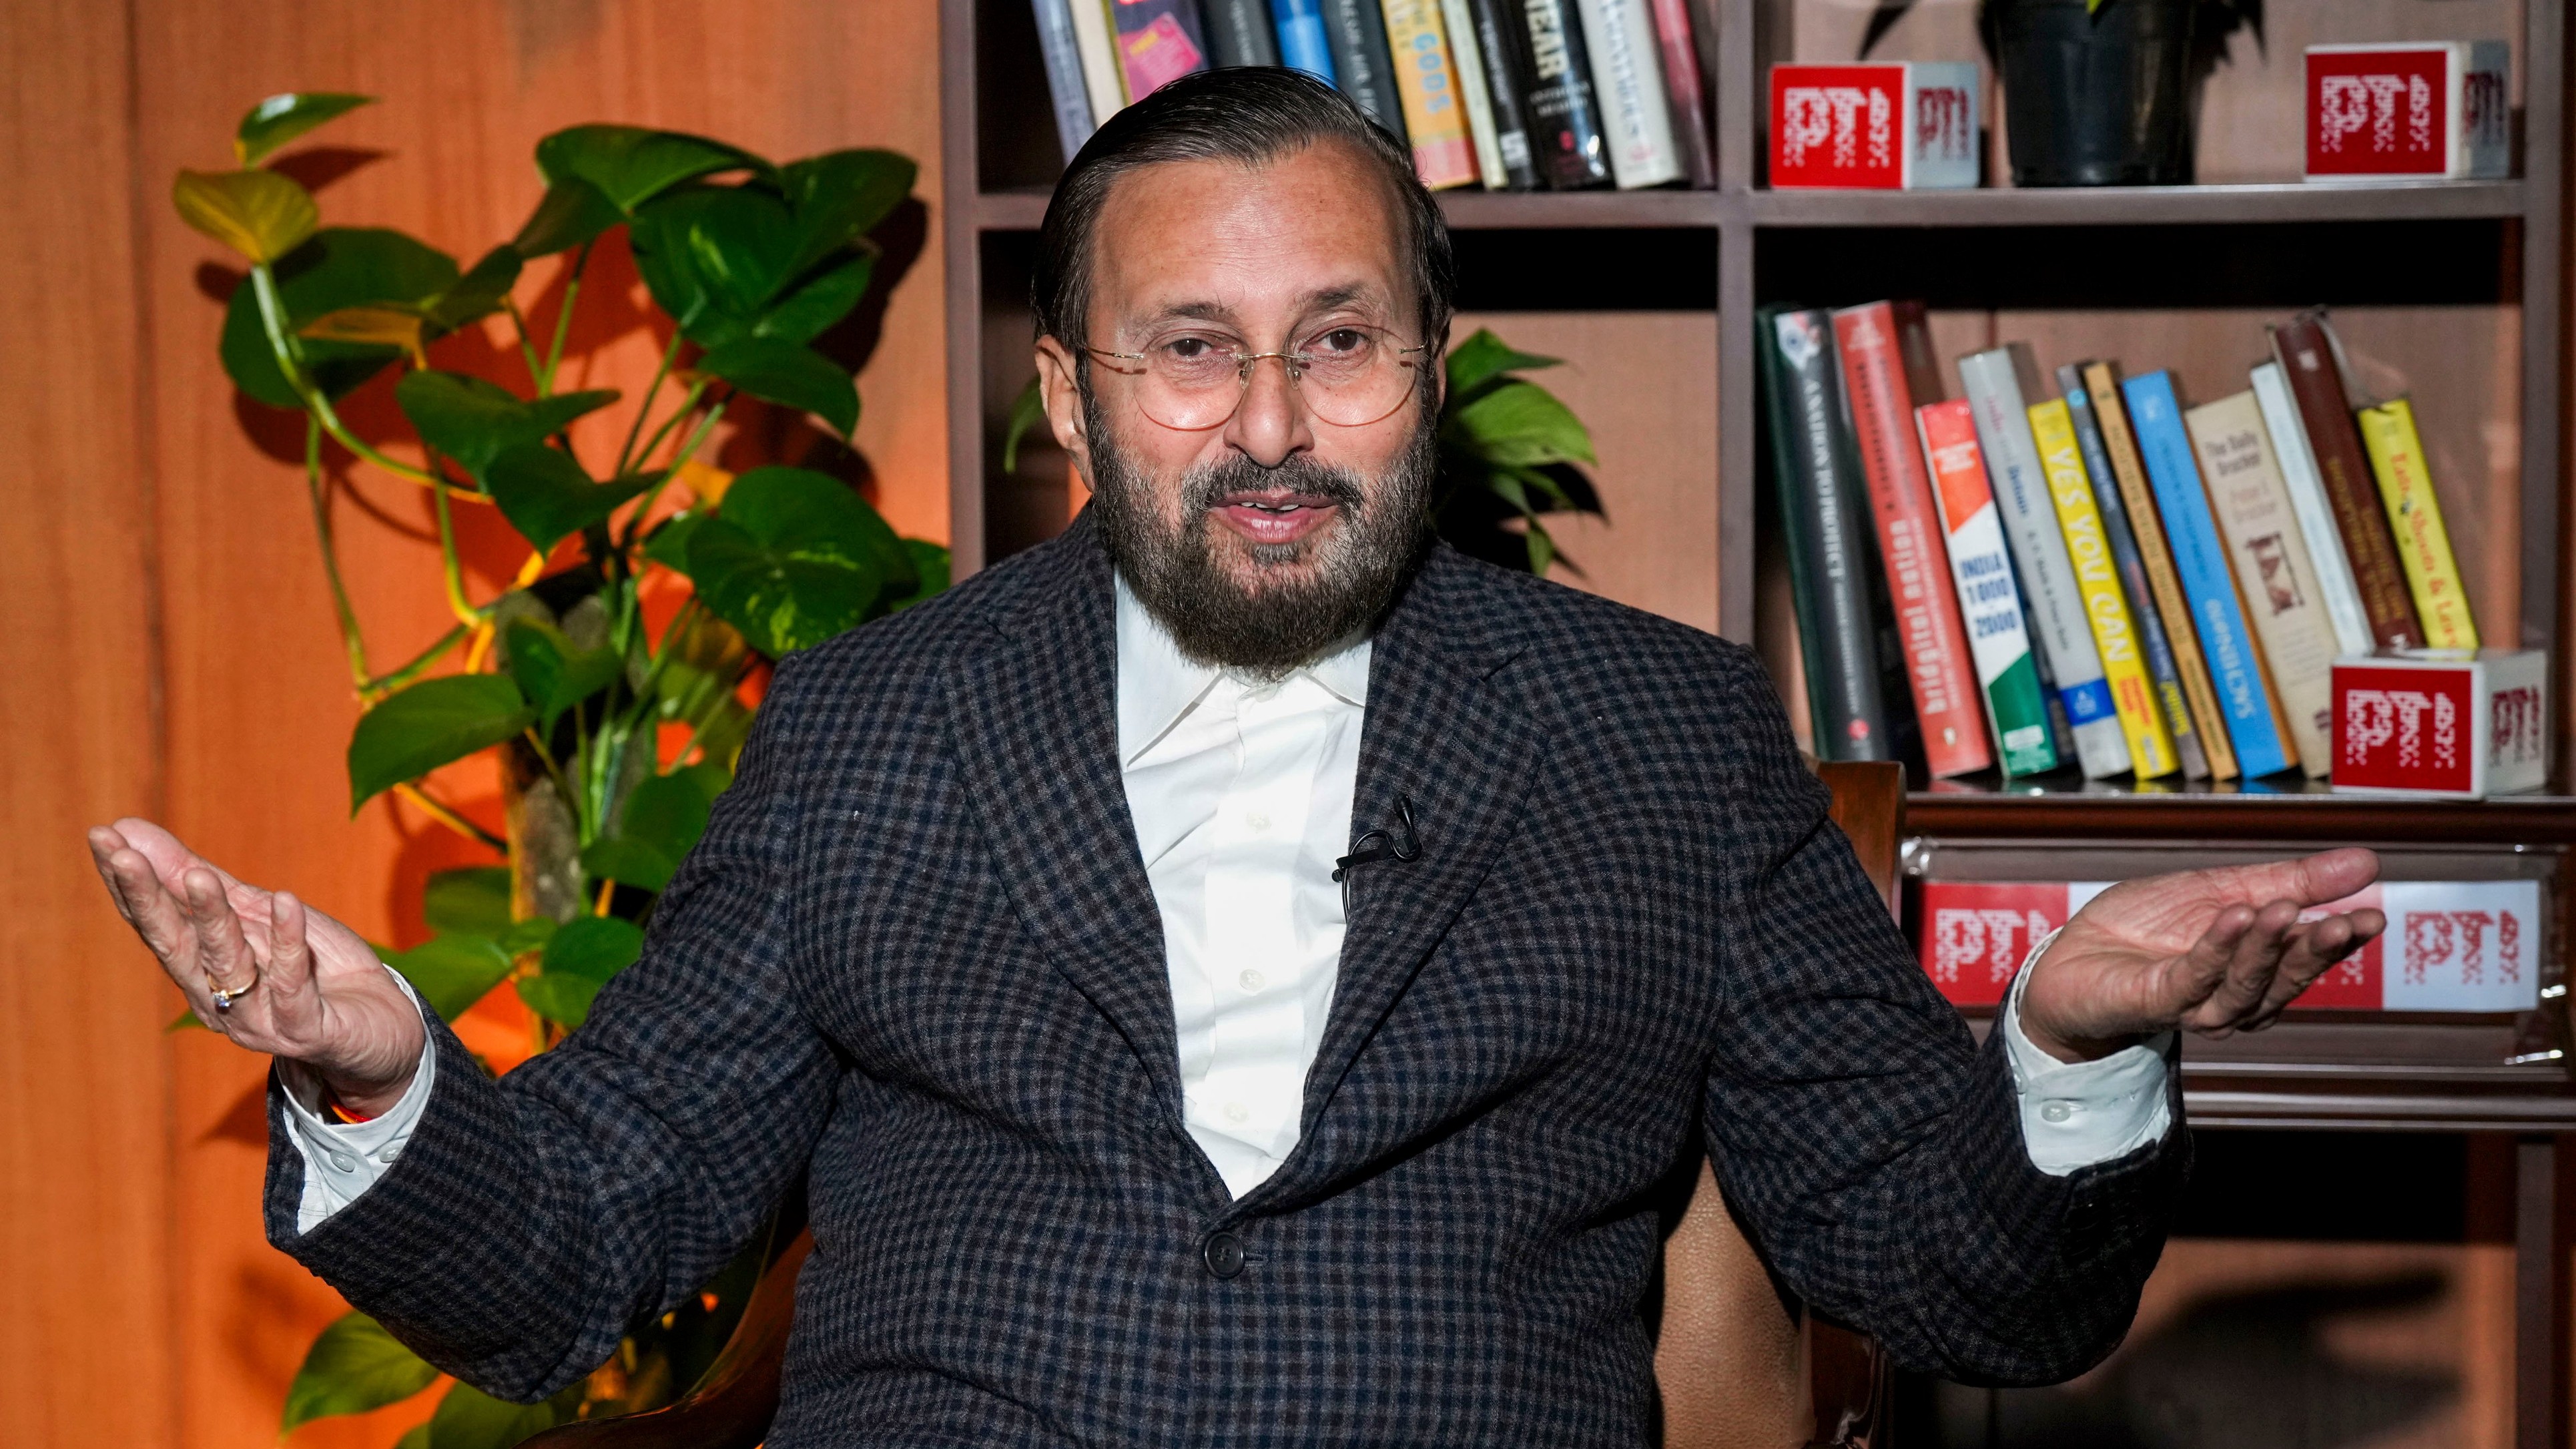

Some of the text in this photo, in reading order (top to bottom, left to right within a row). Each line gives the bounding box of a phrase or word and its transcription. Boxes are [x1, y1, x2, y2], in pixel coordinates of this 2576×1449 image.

[1783, 87, 1890, 168] PTI
[2320, 73, 2431, 152] PTI
[2047, 447, 2089, 508] YES
[2068, 513, 2111, 583] YOU
[2091, 591, 2134, 663] CAN
[2346, 688, 2455, 769] PTI
[2404, 909, 2520, 984] PTI
